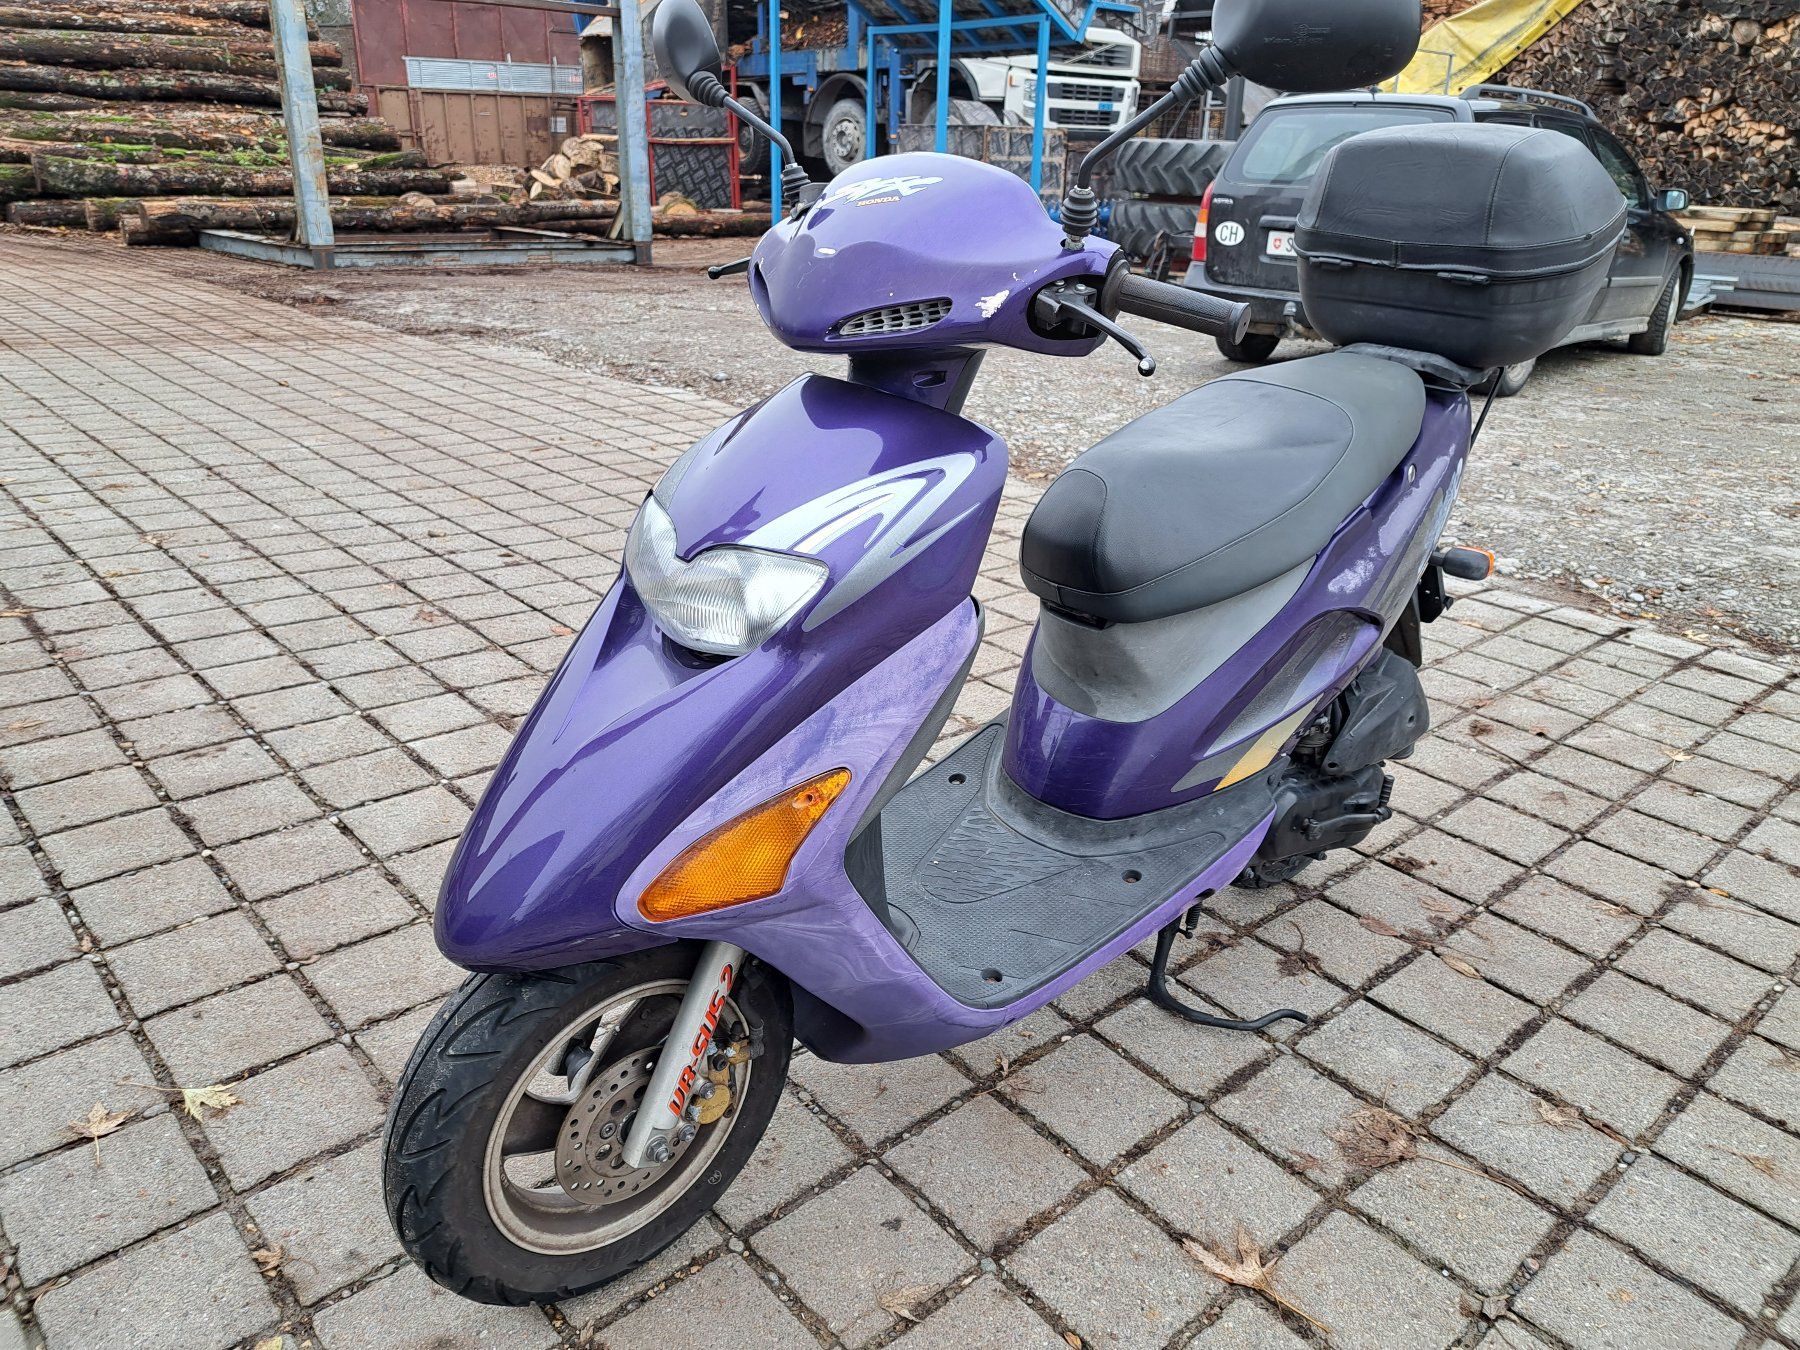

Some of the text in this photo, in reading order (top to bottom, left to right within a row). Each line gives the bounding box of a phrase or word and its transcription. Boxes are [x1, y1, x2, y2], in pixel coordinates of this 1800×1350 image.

[855, 196, 901, 208] HONDA
[1220, 225, 1239, 243] CH
[719, 963, 735, 992] 2
